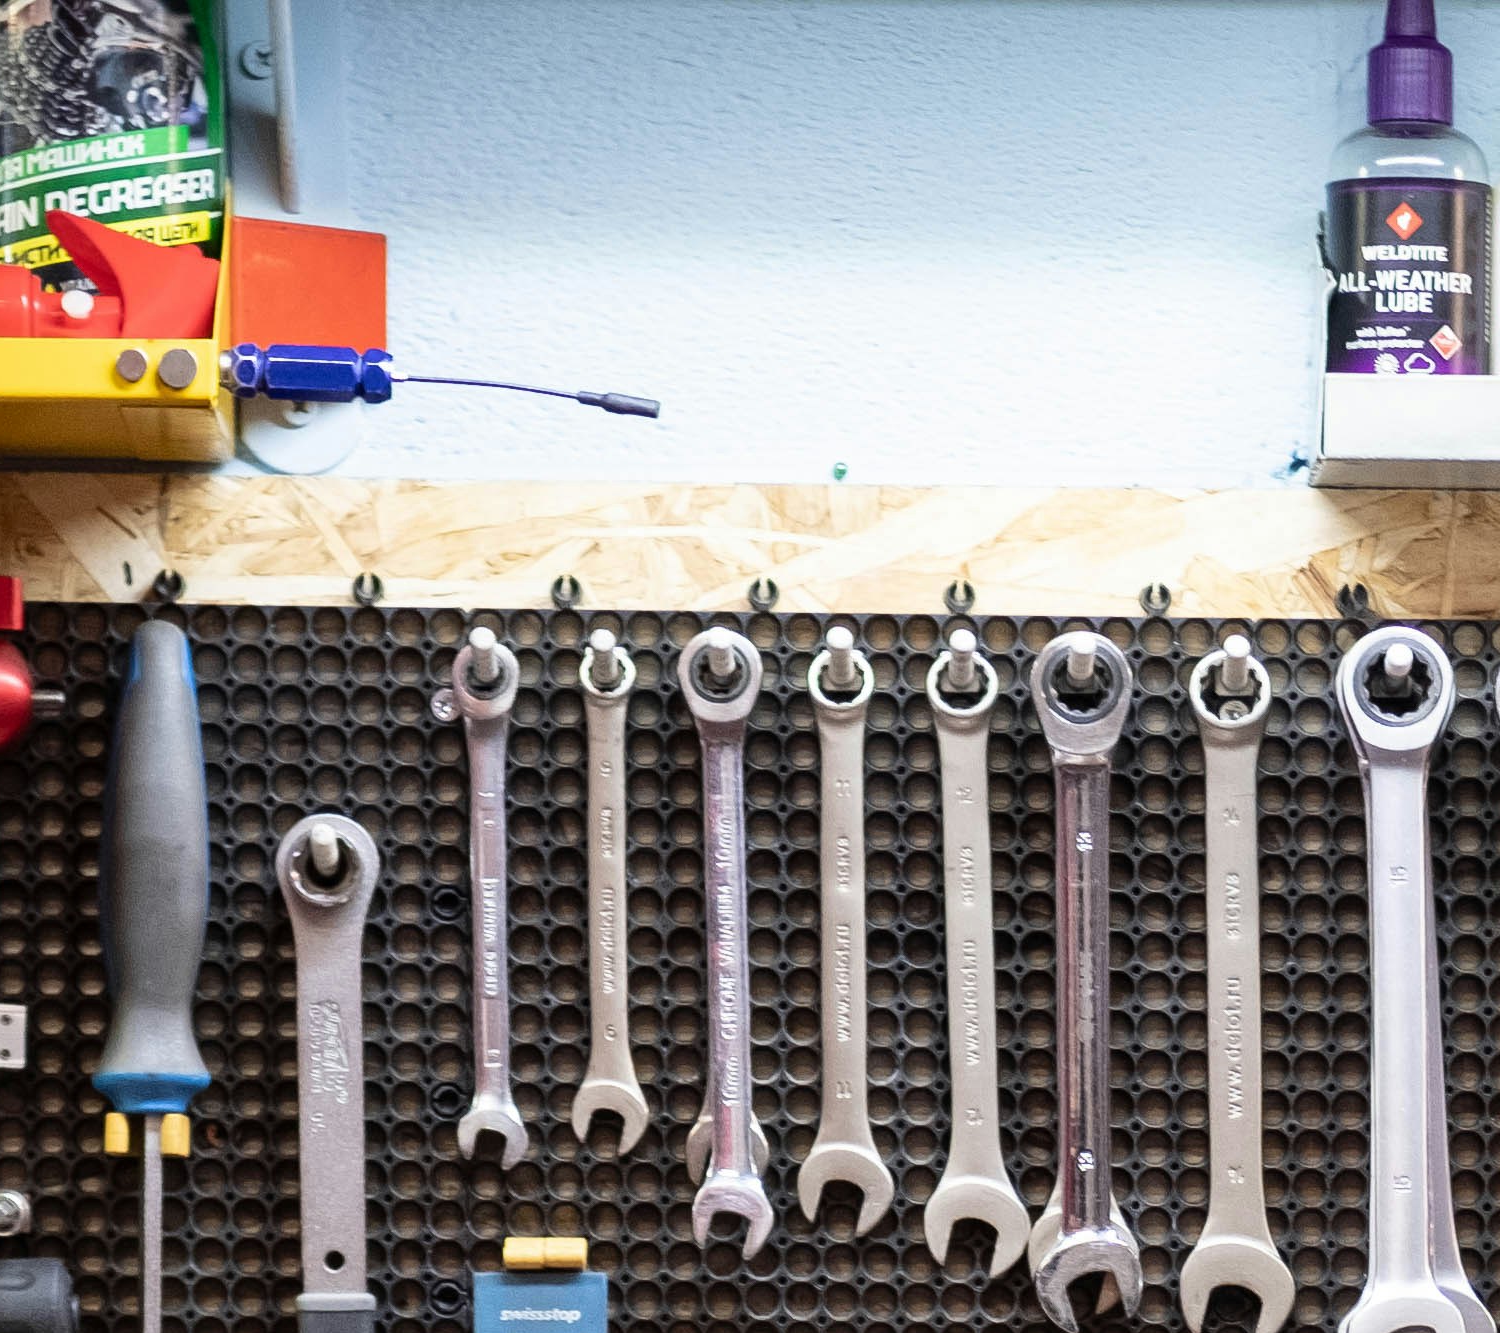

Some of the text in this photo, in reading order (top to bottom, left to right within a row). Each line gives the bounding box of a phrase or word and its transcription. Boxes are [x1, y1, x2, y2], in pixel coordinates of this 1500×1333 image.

[26, 133, 146, 176] МАШИНОК
[45, 168, 216, 217] DEGREASER
[1360, 244, 1449, 262] WELDTITE
[1338, 269, 1473, 295] ALL-WEATHER
[1374, 291, 1434, 314] LUBE
[1388, 865, 1408, 888] 15
[1222, 976, 1244, 1121] www.delot.ru
[1392, 1174, 1412, 1195] 15
